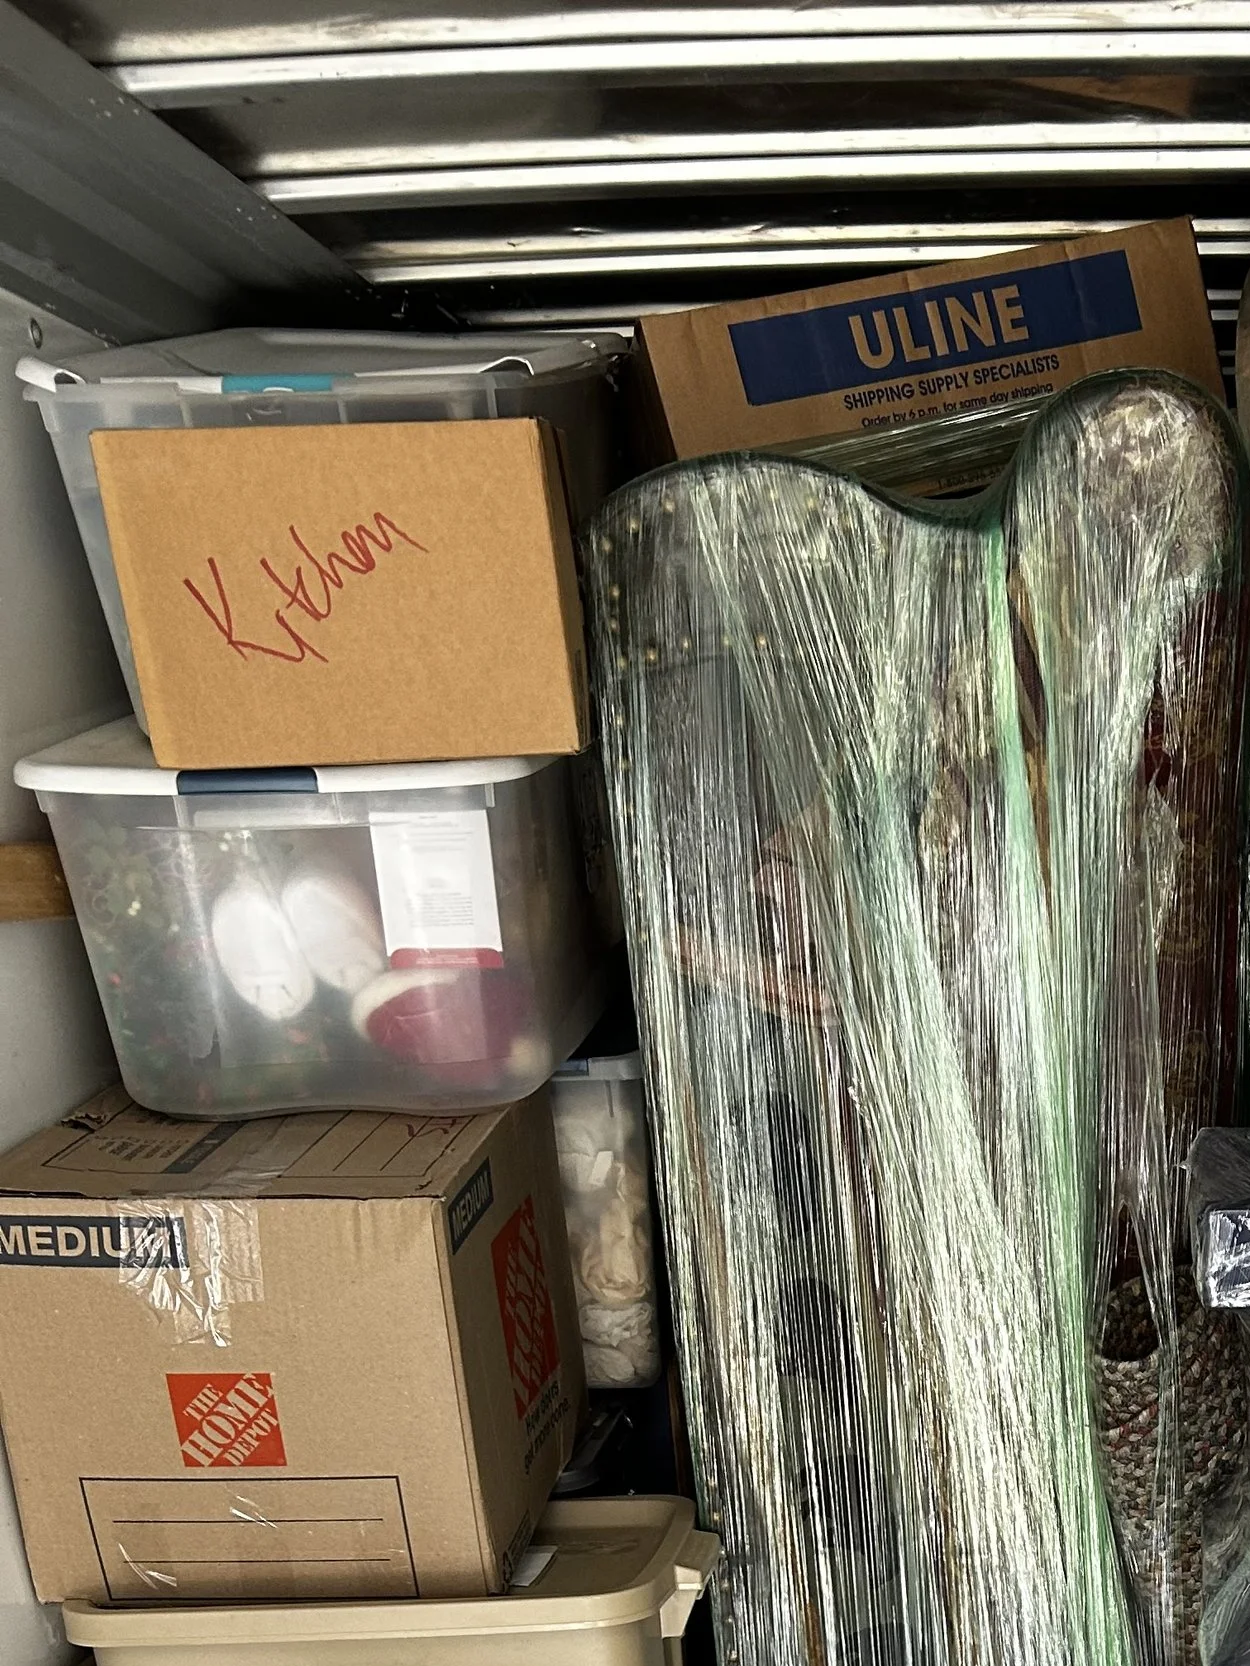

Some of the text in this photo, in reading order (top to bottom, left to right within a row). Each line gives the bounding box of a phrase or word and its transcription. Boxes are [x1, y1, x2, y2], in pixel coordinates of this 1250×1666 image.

[848, 283, 1030, 370] ULINE
[844, 355, 1060, 411] SHIPPING SUPPLY SPECIALISTS
[862, 383, 1054, 429] Order by 6 p.m. for same day shipping
[452, 1171, 491, 1241] MEDIUM
[181, 1373, 276, 1466] HOME
[182, 1383, 223, 1420] THE
[223, 1408, 278, 1466] DEPOT
